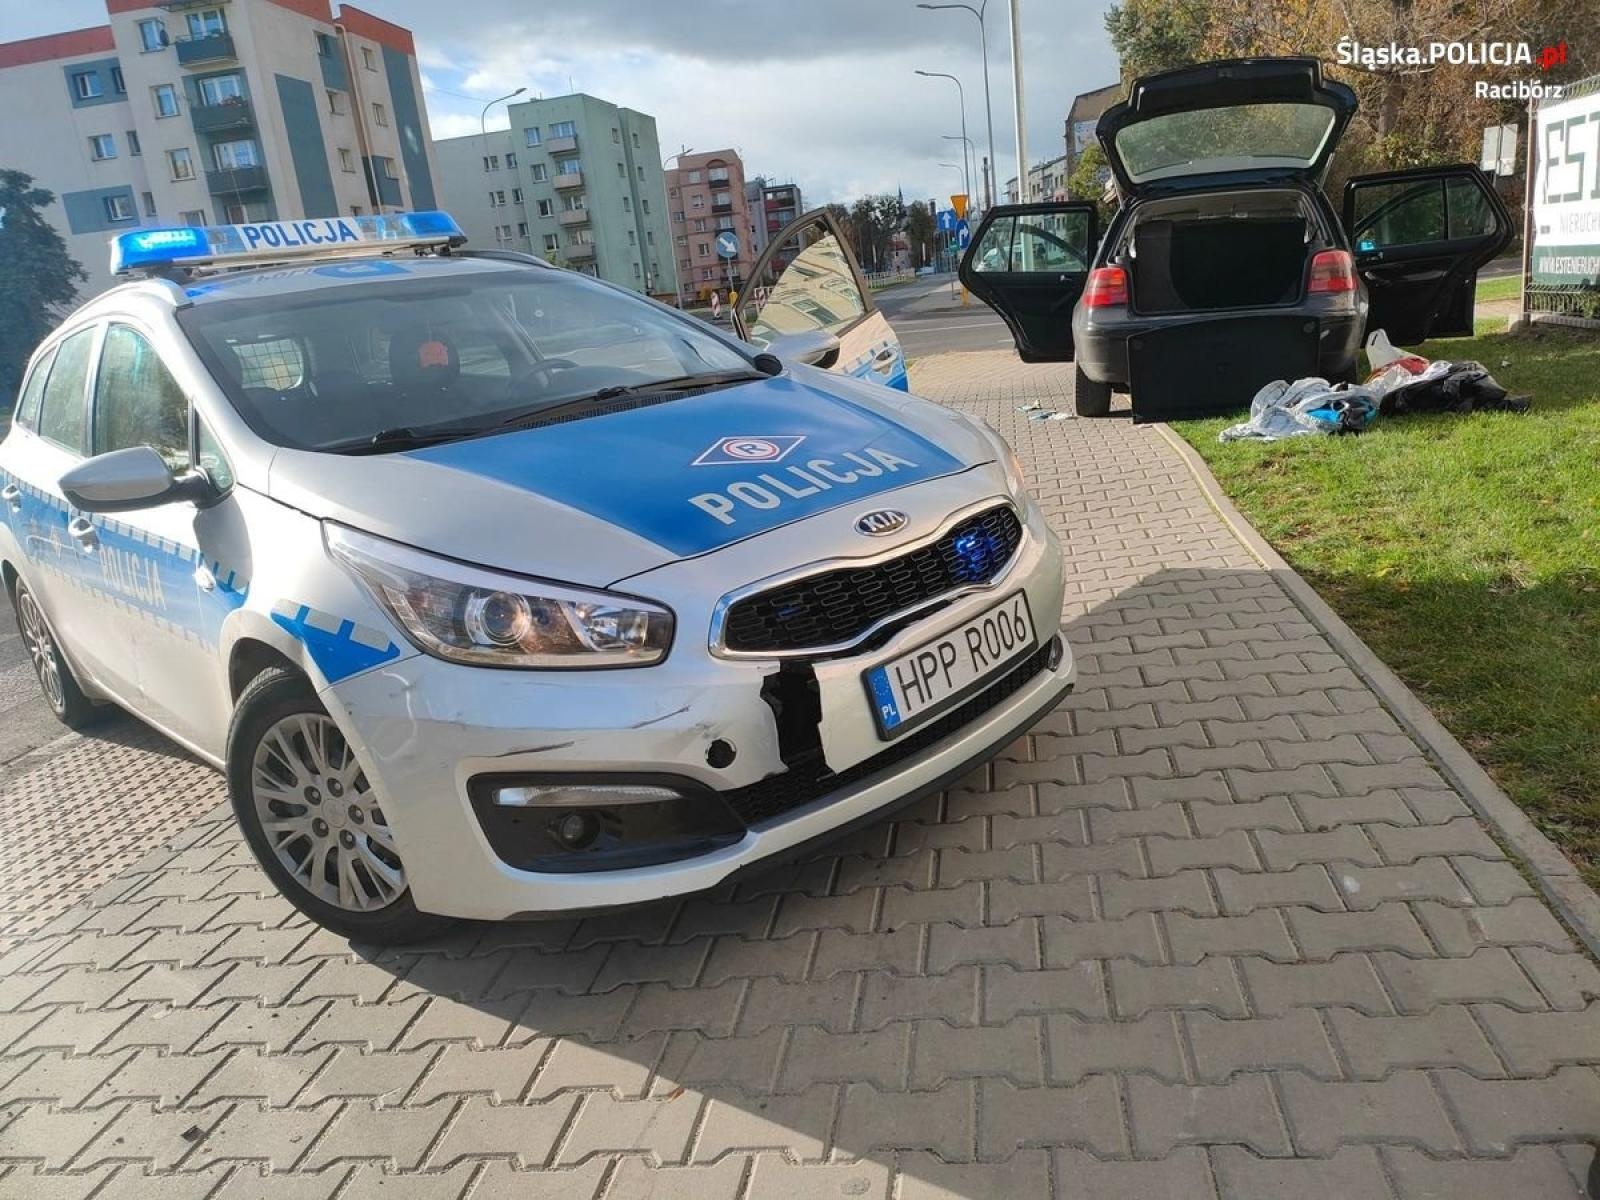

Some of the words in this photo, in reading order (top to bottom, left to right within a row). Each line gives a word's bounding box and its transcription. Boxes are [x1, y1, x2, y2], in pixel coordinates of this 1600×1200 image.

[241, 220, 359, 249] POLICJA
[735, 443, 768, 455] R
[688, 447, 919, 525] POLICJA
[862, 511, 903, 531] KIA
[99, 543, 167, 611] POLICJA
[895, 641, 957, 712] HPP
[964, 600, 1026, 673] R006
[881, 703, 897, 719] PL
